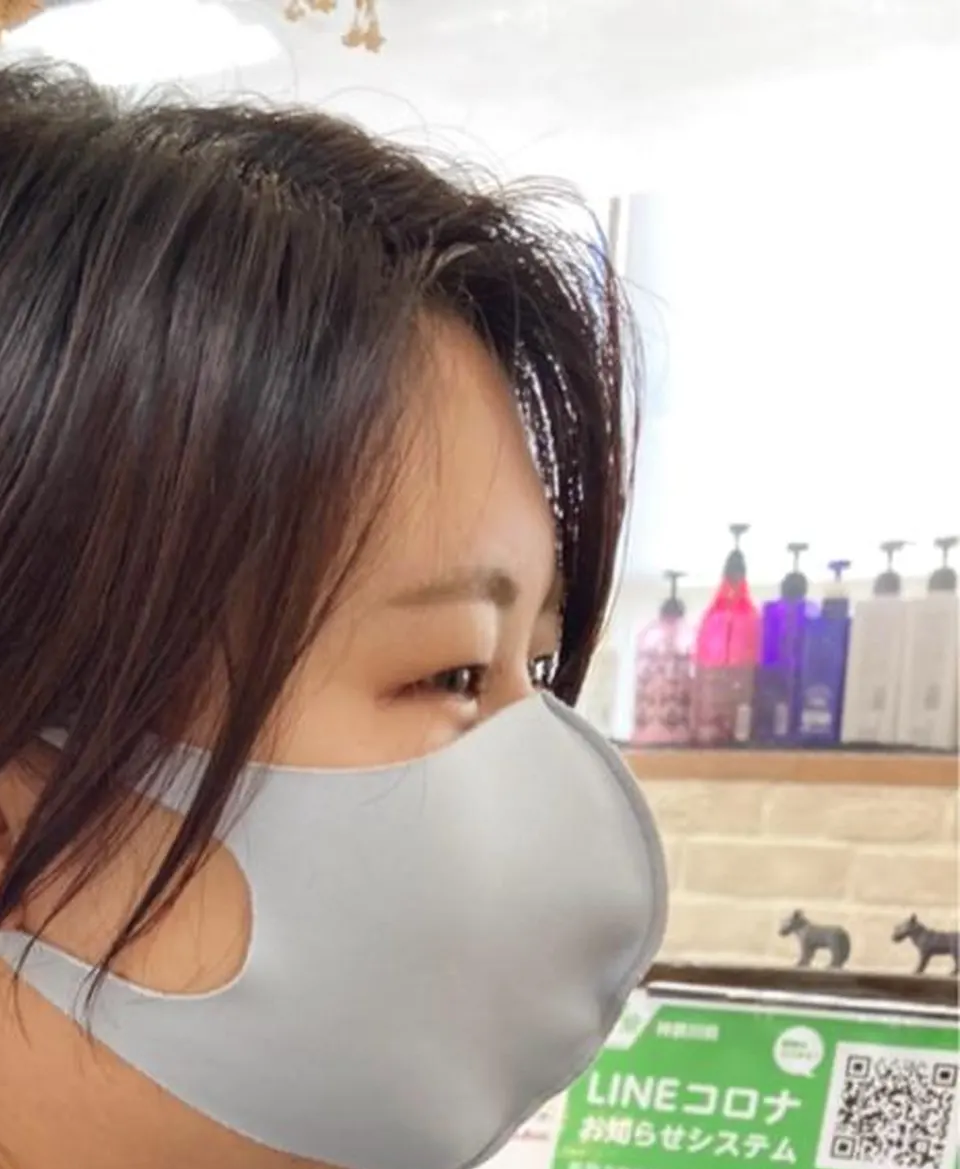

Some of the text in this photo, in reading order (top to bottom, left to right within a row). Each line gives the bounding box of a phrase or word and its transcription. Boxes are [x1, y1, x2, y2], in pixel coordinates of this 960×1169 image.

[586, 1070, 802, 1125] LINEコロナ
[578, 1115, 797, 1164] お知らせシステム
